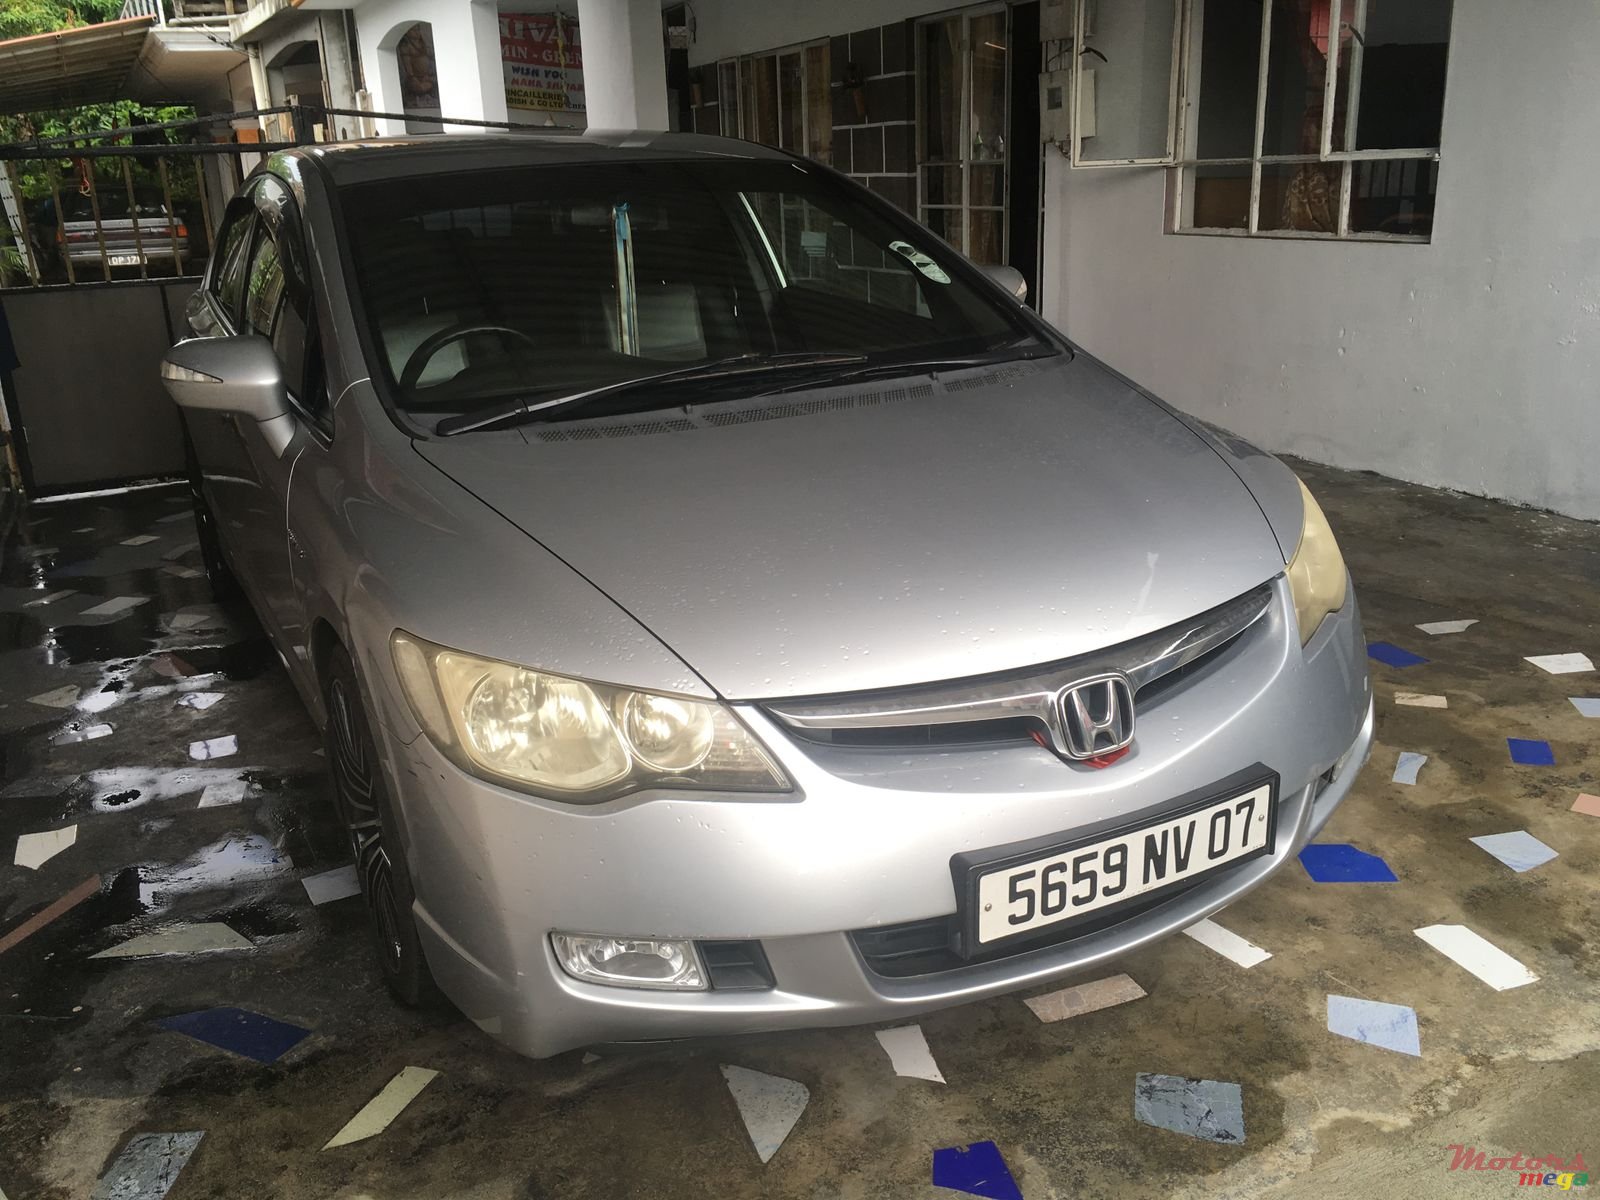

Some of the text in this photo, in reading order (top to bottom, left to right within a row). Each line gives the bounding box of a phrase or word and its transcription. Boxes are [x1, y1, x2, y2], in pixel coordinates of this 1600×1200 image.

[512, 65, 539, 77] WISH
[1008, 797, 1255, 926] 5659 NV 07
